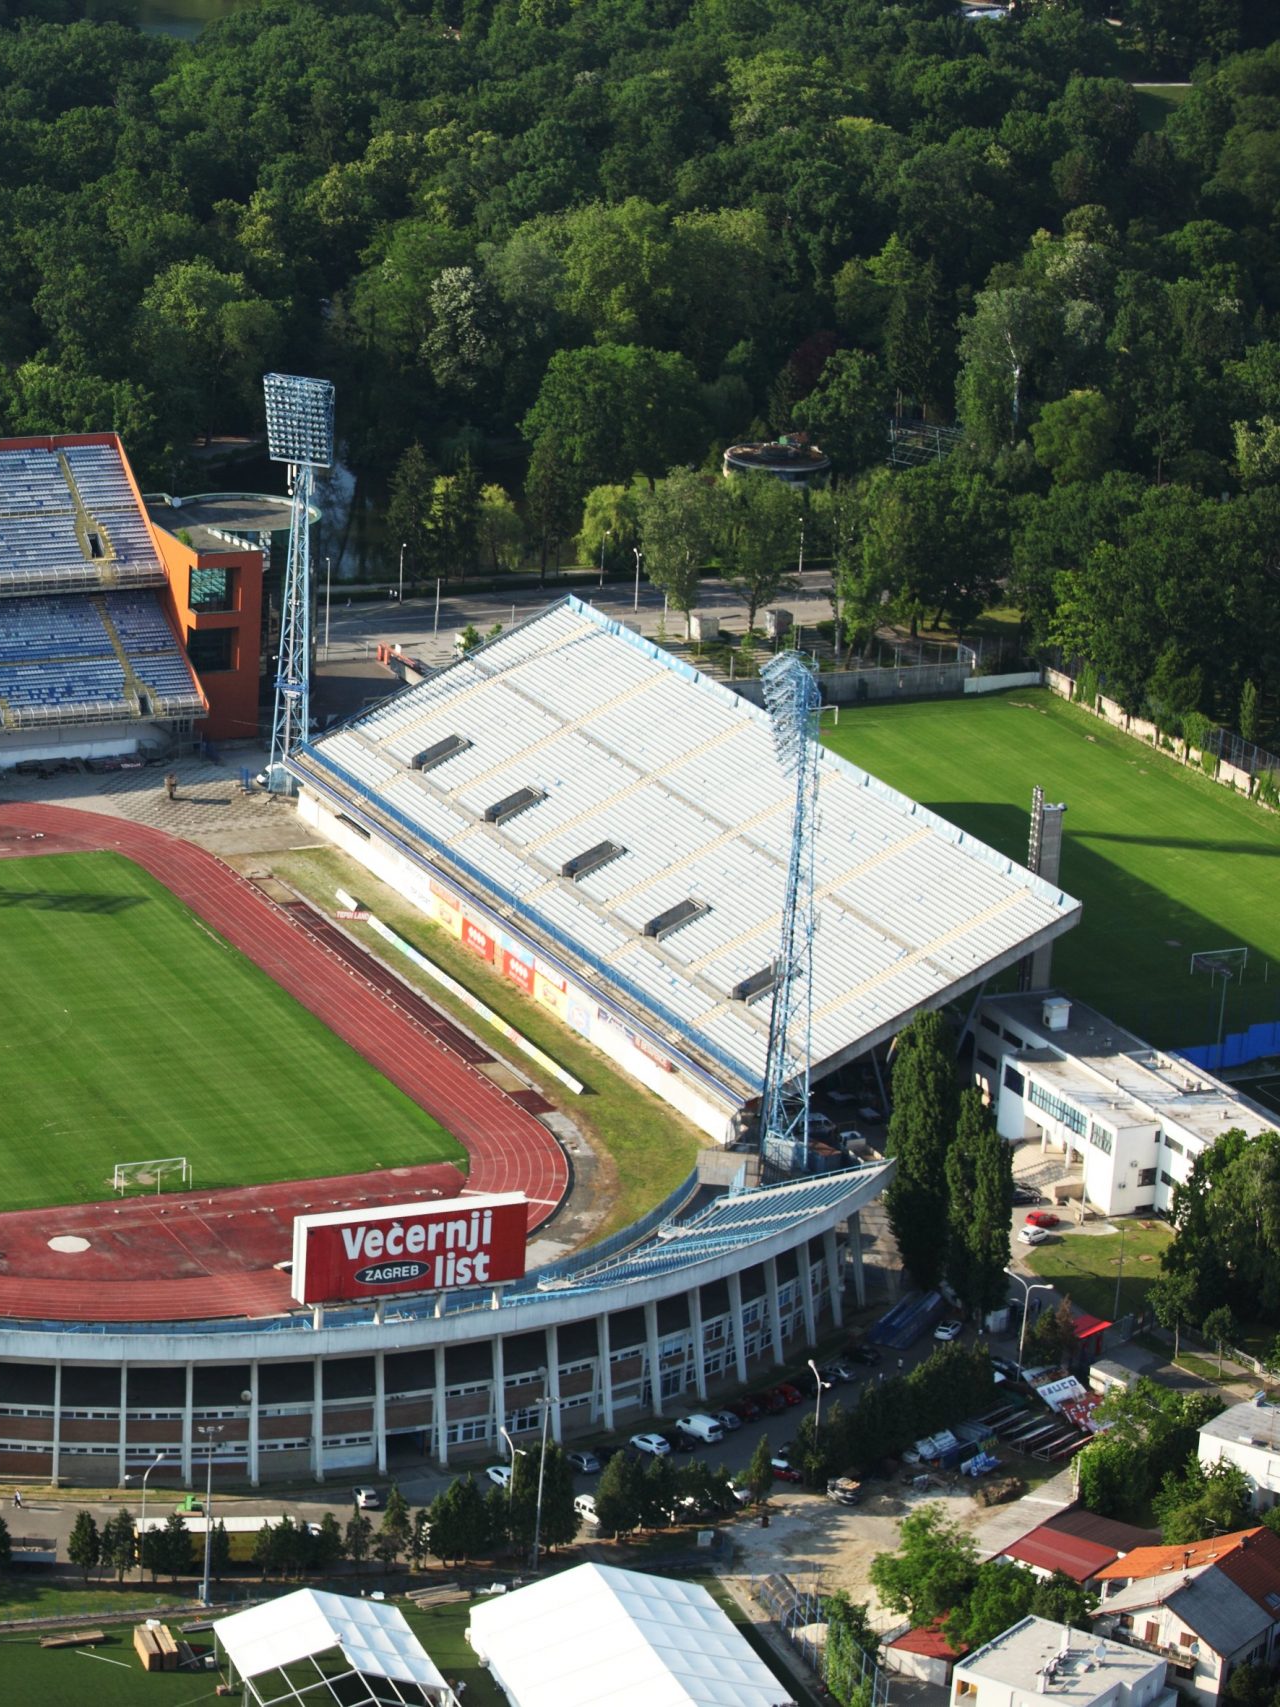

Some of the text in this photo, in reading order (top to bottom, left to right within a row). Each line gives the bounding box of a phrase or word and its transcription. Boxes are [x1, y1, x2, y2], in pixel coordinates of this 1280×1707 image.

[342, 1210, 493, 1260] Večernji
[365, 1265, 420, 1281] ZAGREB
[434, 1251, 490, 1287] list
